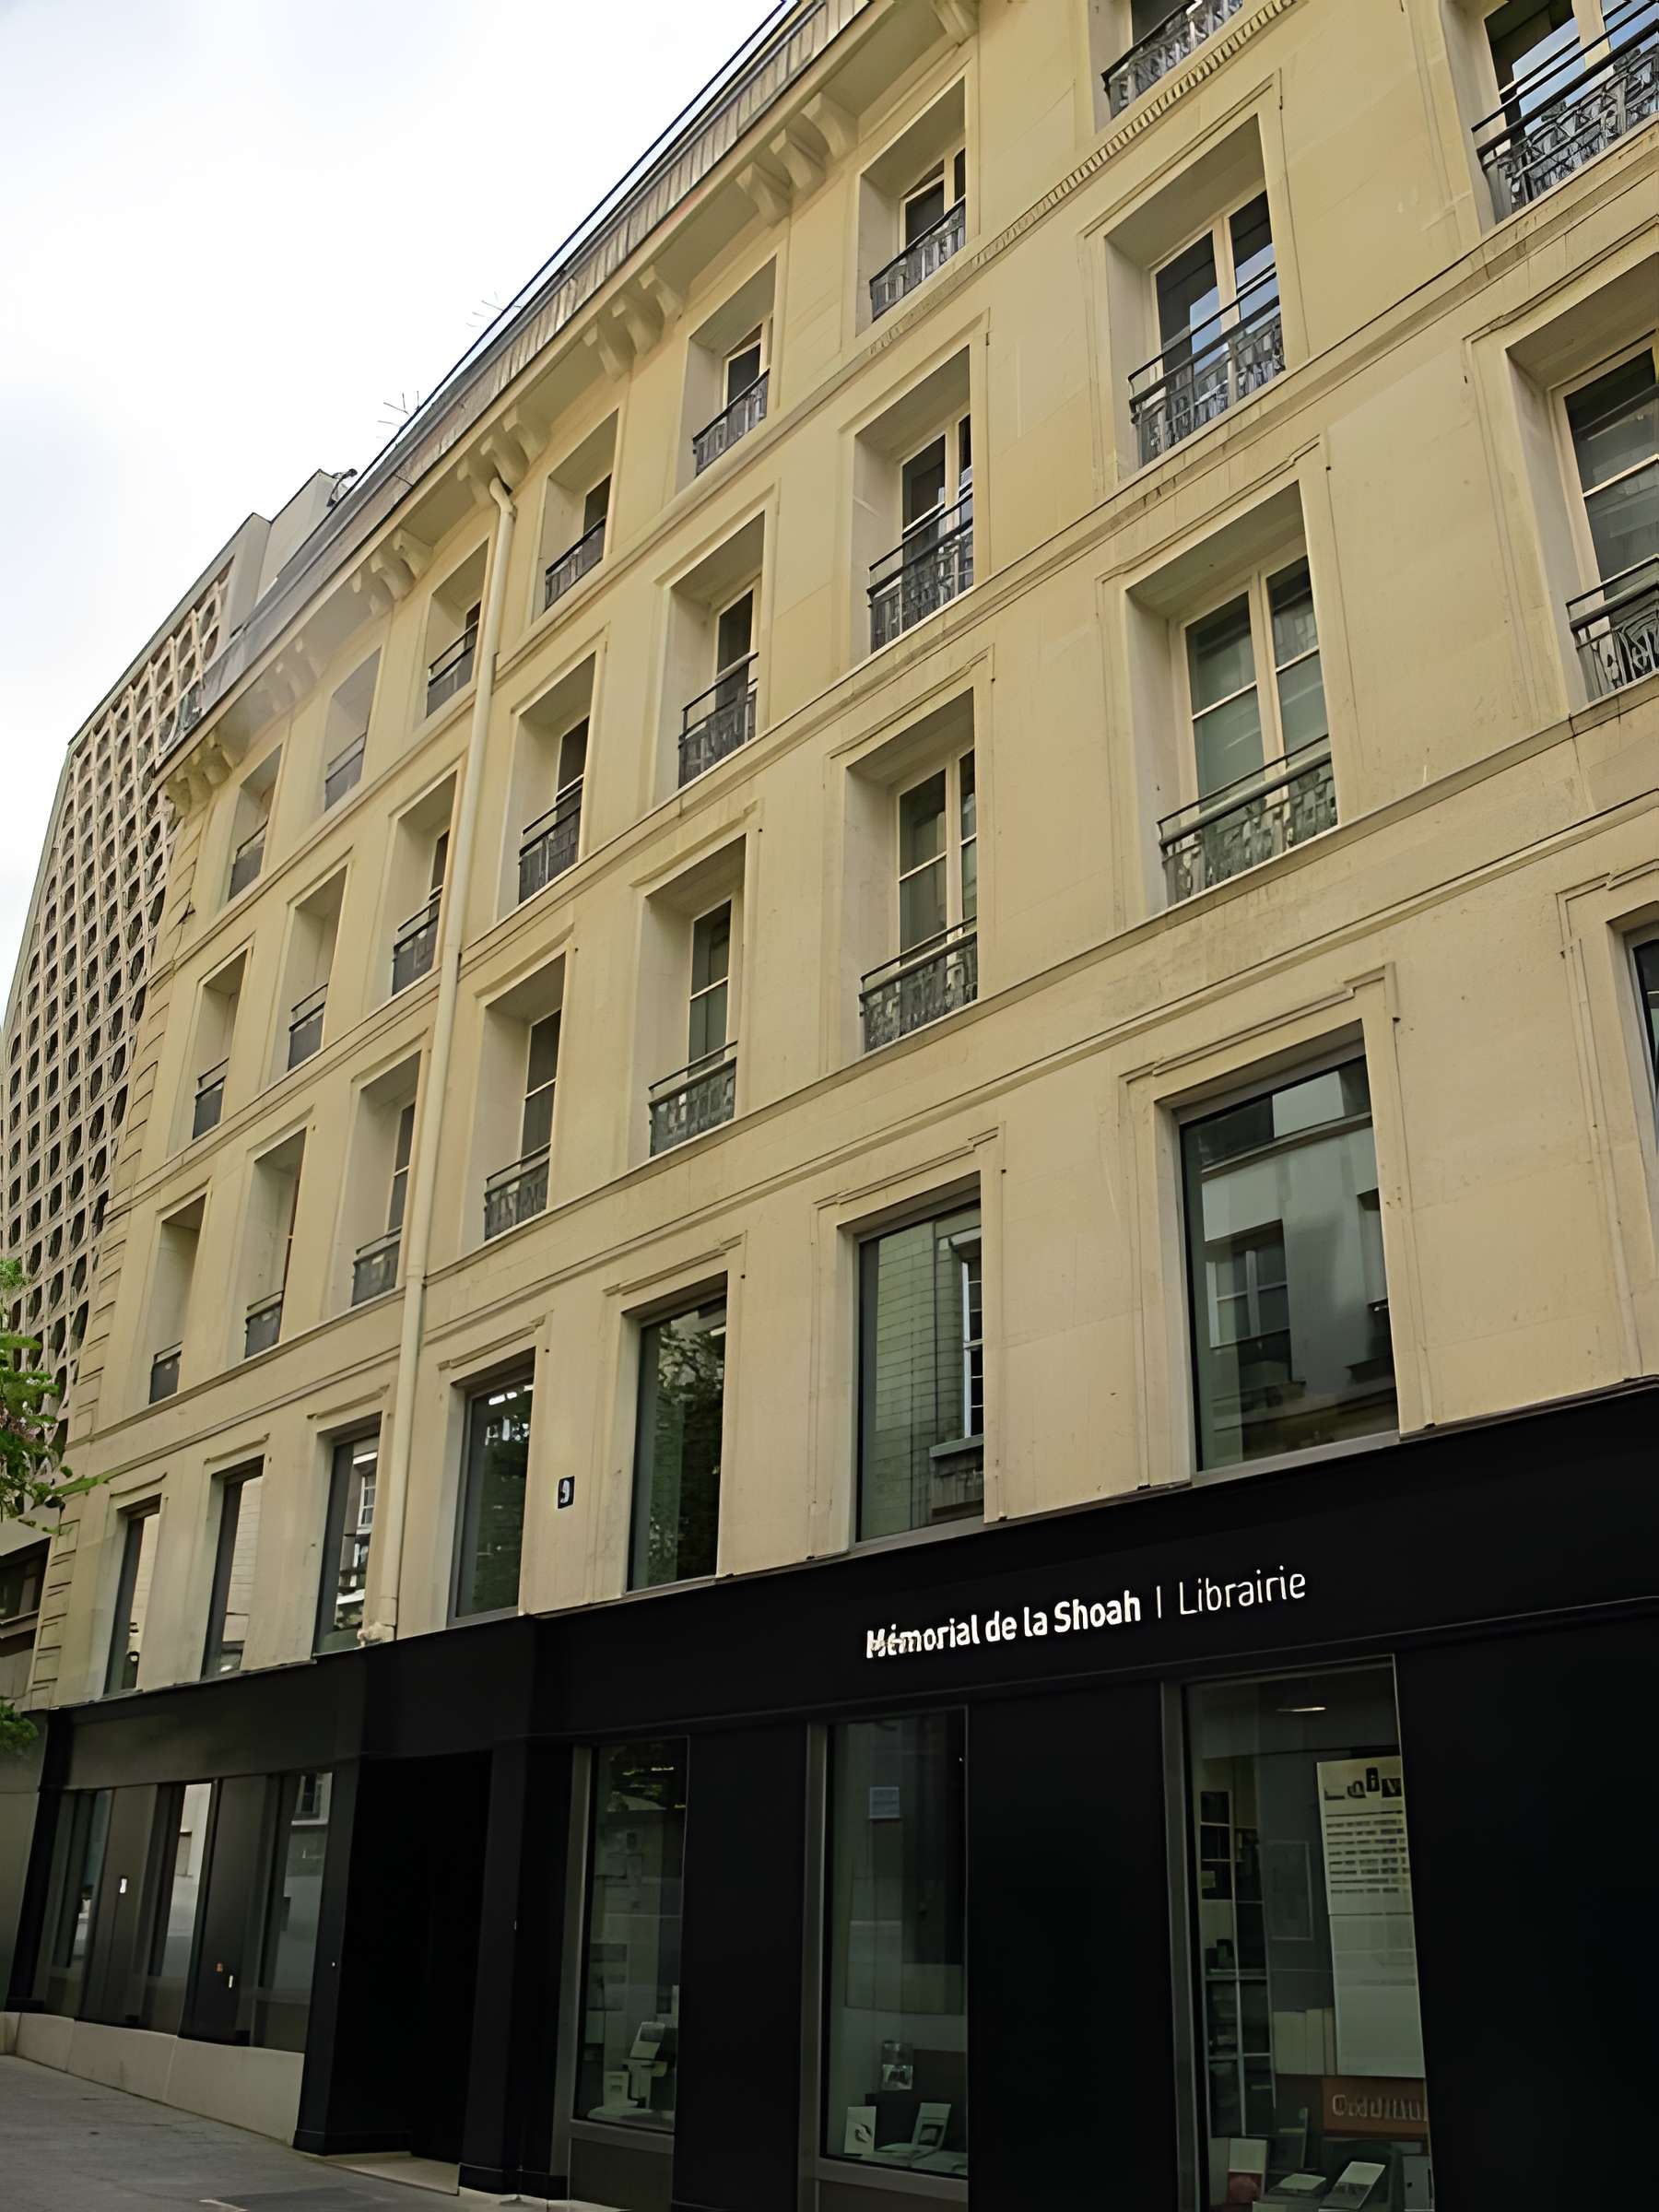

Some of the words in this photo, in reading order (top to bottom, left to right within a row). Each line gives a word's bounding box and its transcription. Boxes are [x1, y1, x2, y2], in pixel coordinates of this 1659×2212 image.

[865, 1613, 981, 1659] Mémorial
[984, 1609, 1018, 1642] de
[1023, 1606, 1048, 1637] la
[1053, 1588, 1141, 1633] Shoah
[1178, 1564, 1307, 1616] Librairie
